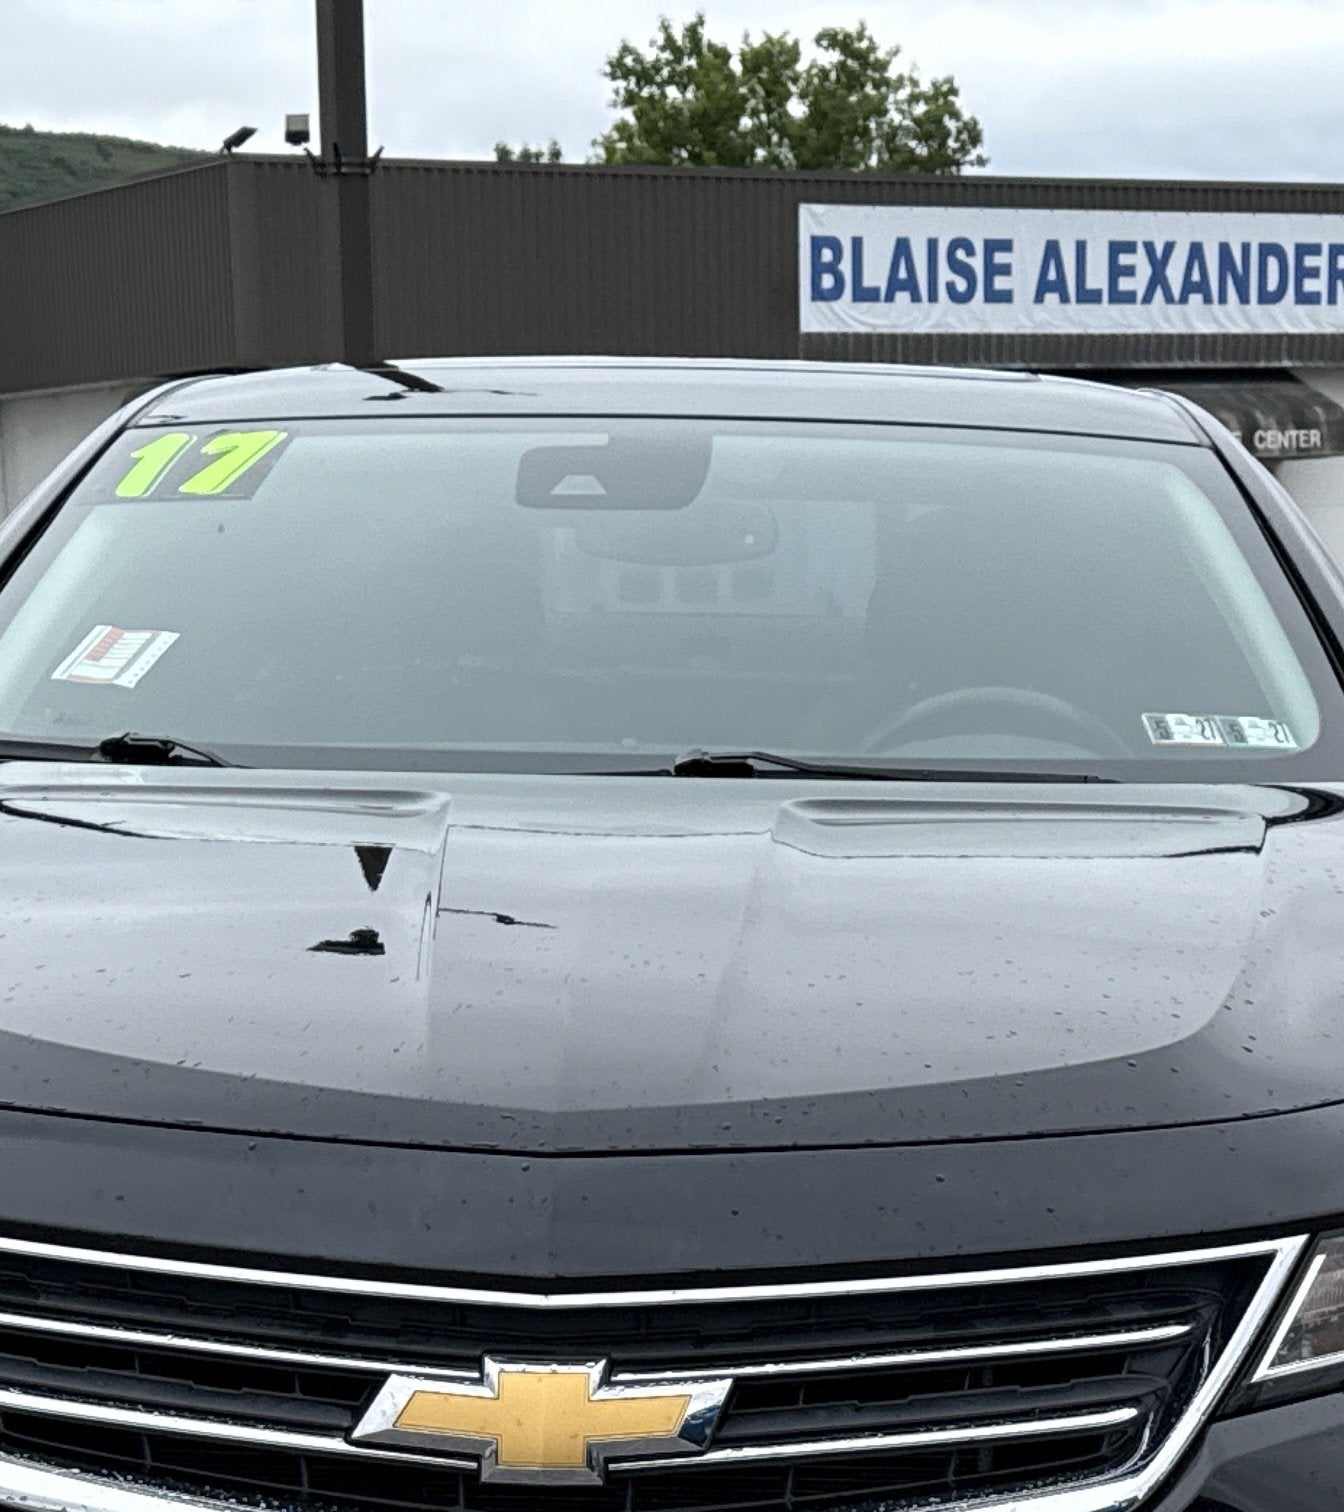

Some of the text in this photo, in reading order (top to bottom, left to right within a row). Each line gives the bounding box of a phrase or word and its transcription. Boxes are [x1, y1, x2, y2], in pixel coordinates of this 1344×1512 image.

[809, 234, 1015, 304] BLAISE
[115, 430, 289, 498] 17
[1253, 428, 1323, 450] CENTER
